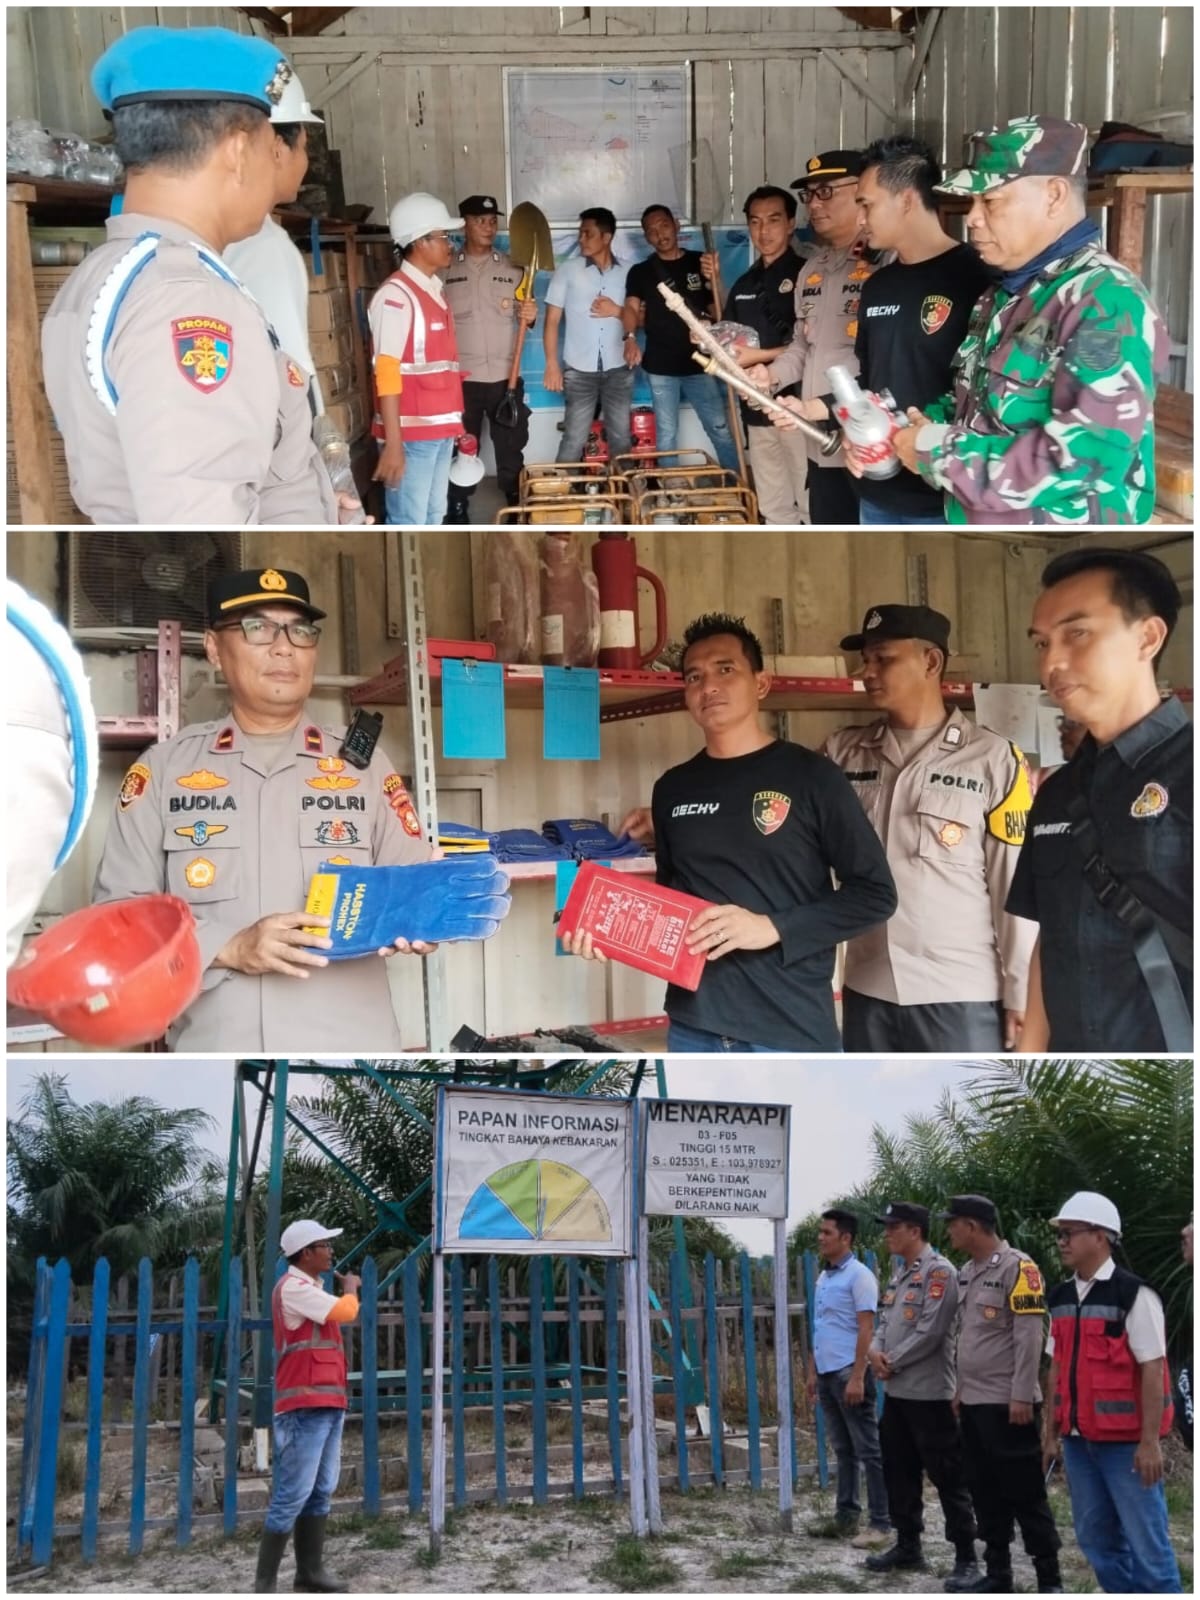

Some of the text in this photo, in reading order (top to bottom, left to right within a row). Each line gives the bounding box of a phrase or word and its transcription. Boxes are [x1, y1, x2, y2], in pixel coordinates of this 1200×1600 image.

[842, 284, 861, 294] POL
[177, 319, 228, 334] PROPAM
[930, 773, 984, 794] POLRI
[169, 795, 237, 813] BUDI.A
[302, 796, 365, 811] POLRI
[342, 883, 367, 940] HASSTON
[458, 1110, 619, 1132] PAPAN INFORMASI
[459, 1131, 618, 1148] TINGKAT BAHAYA KEBAKARAN
[680, 1143, 756, 1155] TINGGI 15 MTR
[652, 1155, 660, 1166] S
[711, 1157, 718, 1167] E
[686, 1173, 750, 1184] YANG TIDAK
[668, 1186, 767, 1199] BERKEPENTINGAN
[675, 1200, 760, 1212] DILARANG NAIK
